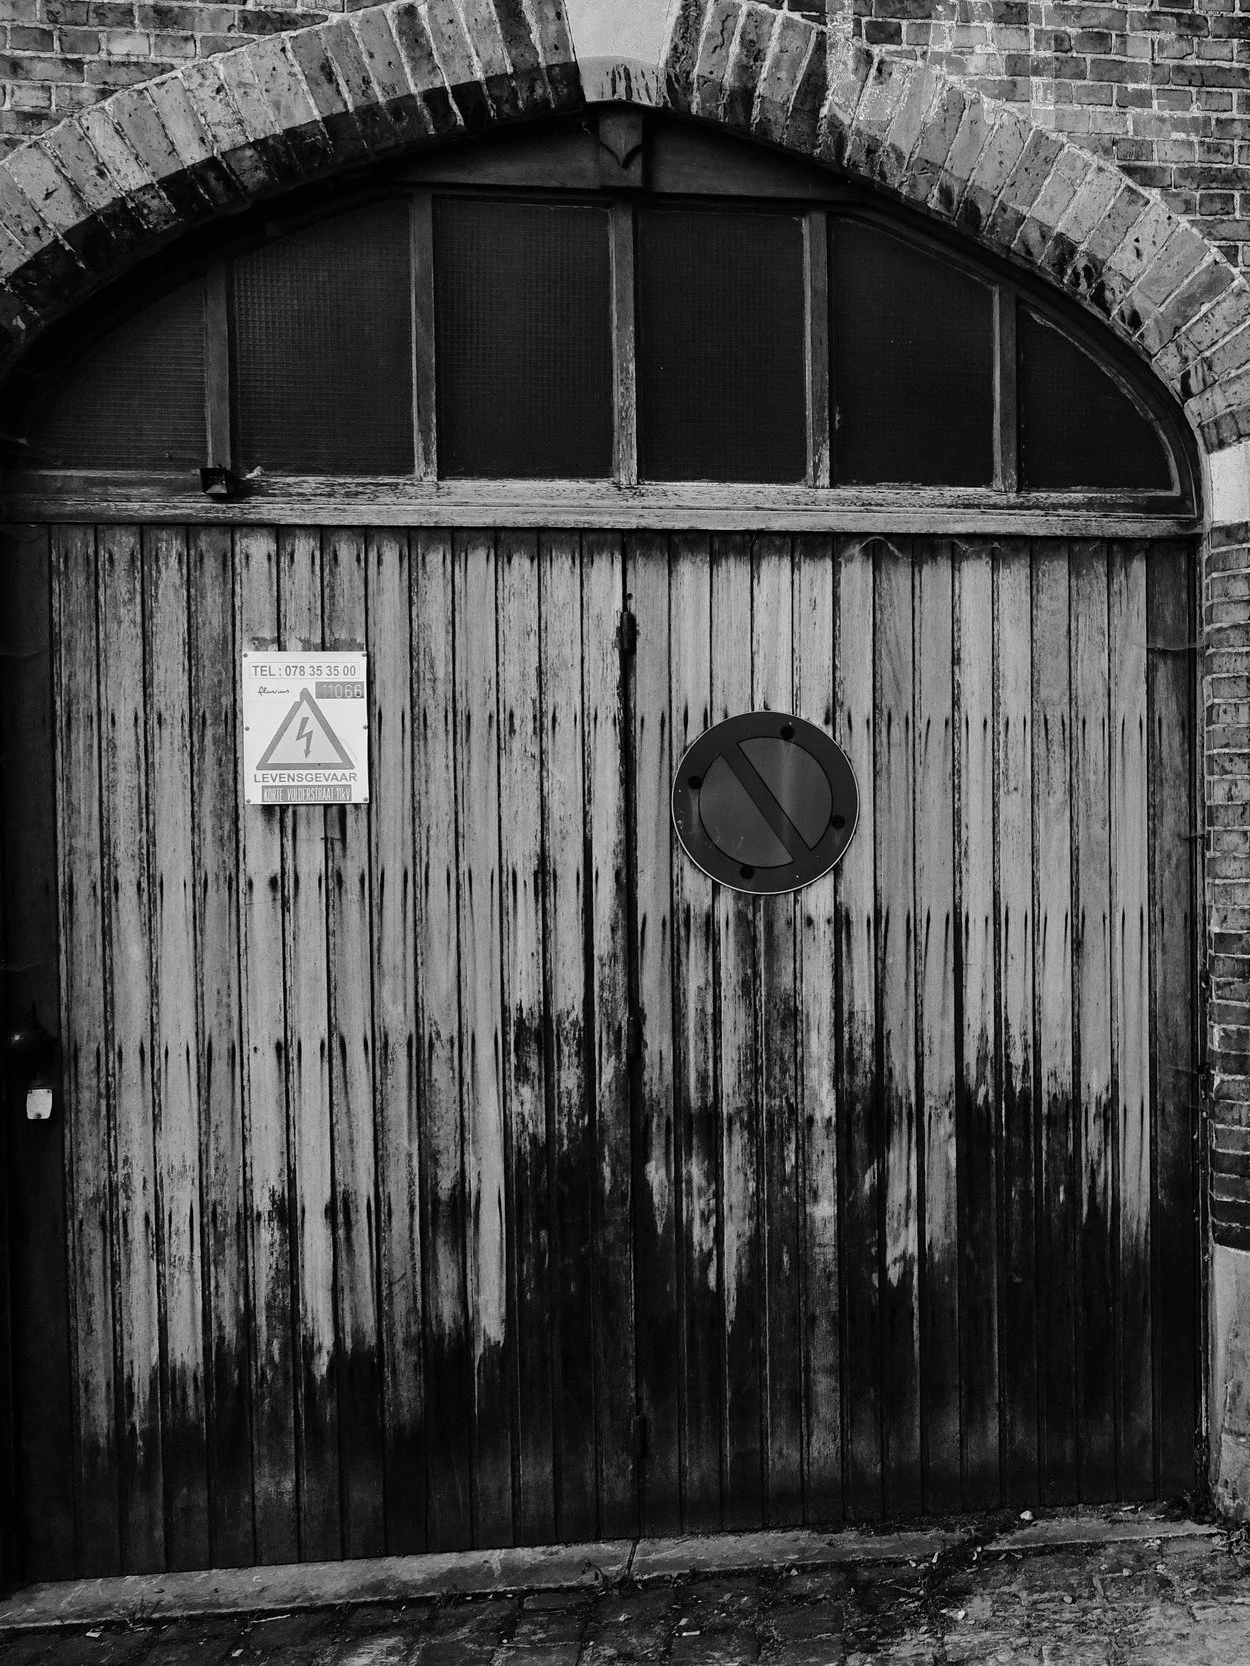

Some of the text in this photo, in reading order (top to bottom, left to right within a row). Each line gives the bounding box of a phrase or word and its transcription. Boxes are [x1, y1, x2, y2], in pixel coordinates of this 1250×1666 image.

[284, 665, 306, 676] 078
[308, 665, 323, 676] 35
[325, 665, 340, 676] 35
[342, 665, 356, 676] 00
[254, 772, 357, 783] LEVENSGEVAAR
[263, 787, 284, 801] KORTE
[287, 786, 334, 801] VULDERSTRAAT
